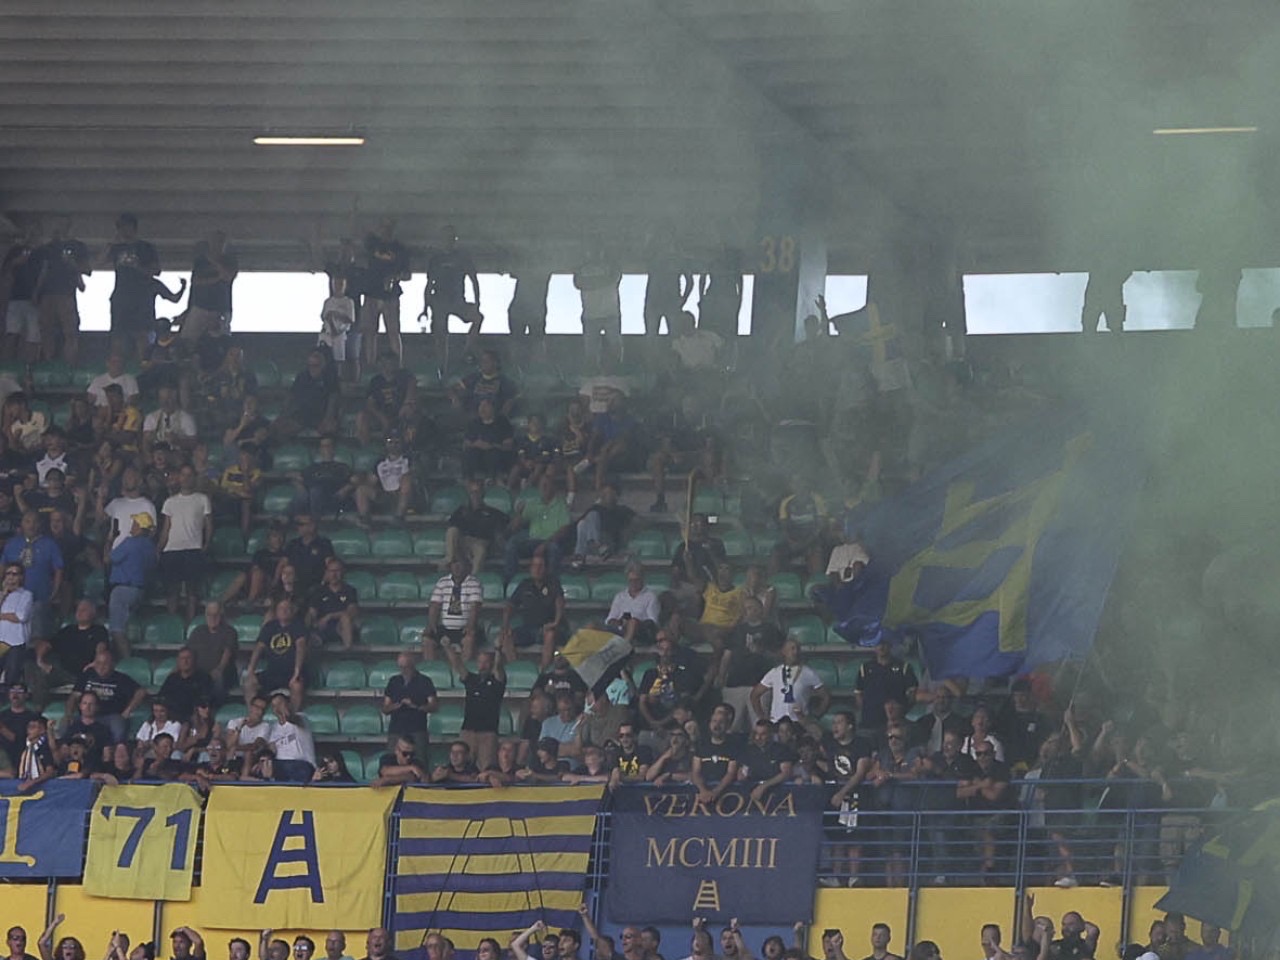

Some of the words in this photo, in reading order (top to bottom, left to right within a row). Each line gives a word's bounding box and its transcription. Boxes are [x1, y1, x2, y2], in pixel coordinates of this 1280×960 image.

[760, 234, 796, 273] 38
[643, 791, 798, 818] VERONA
[646, 836, 780, 869] MCMIII
